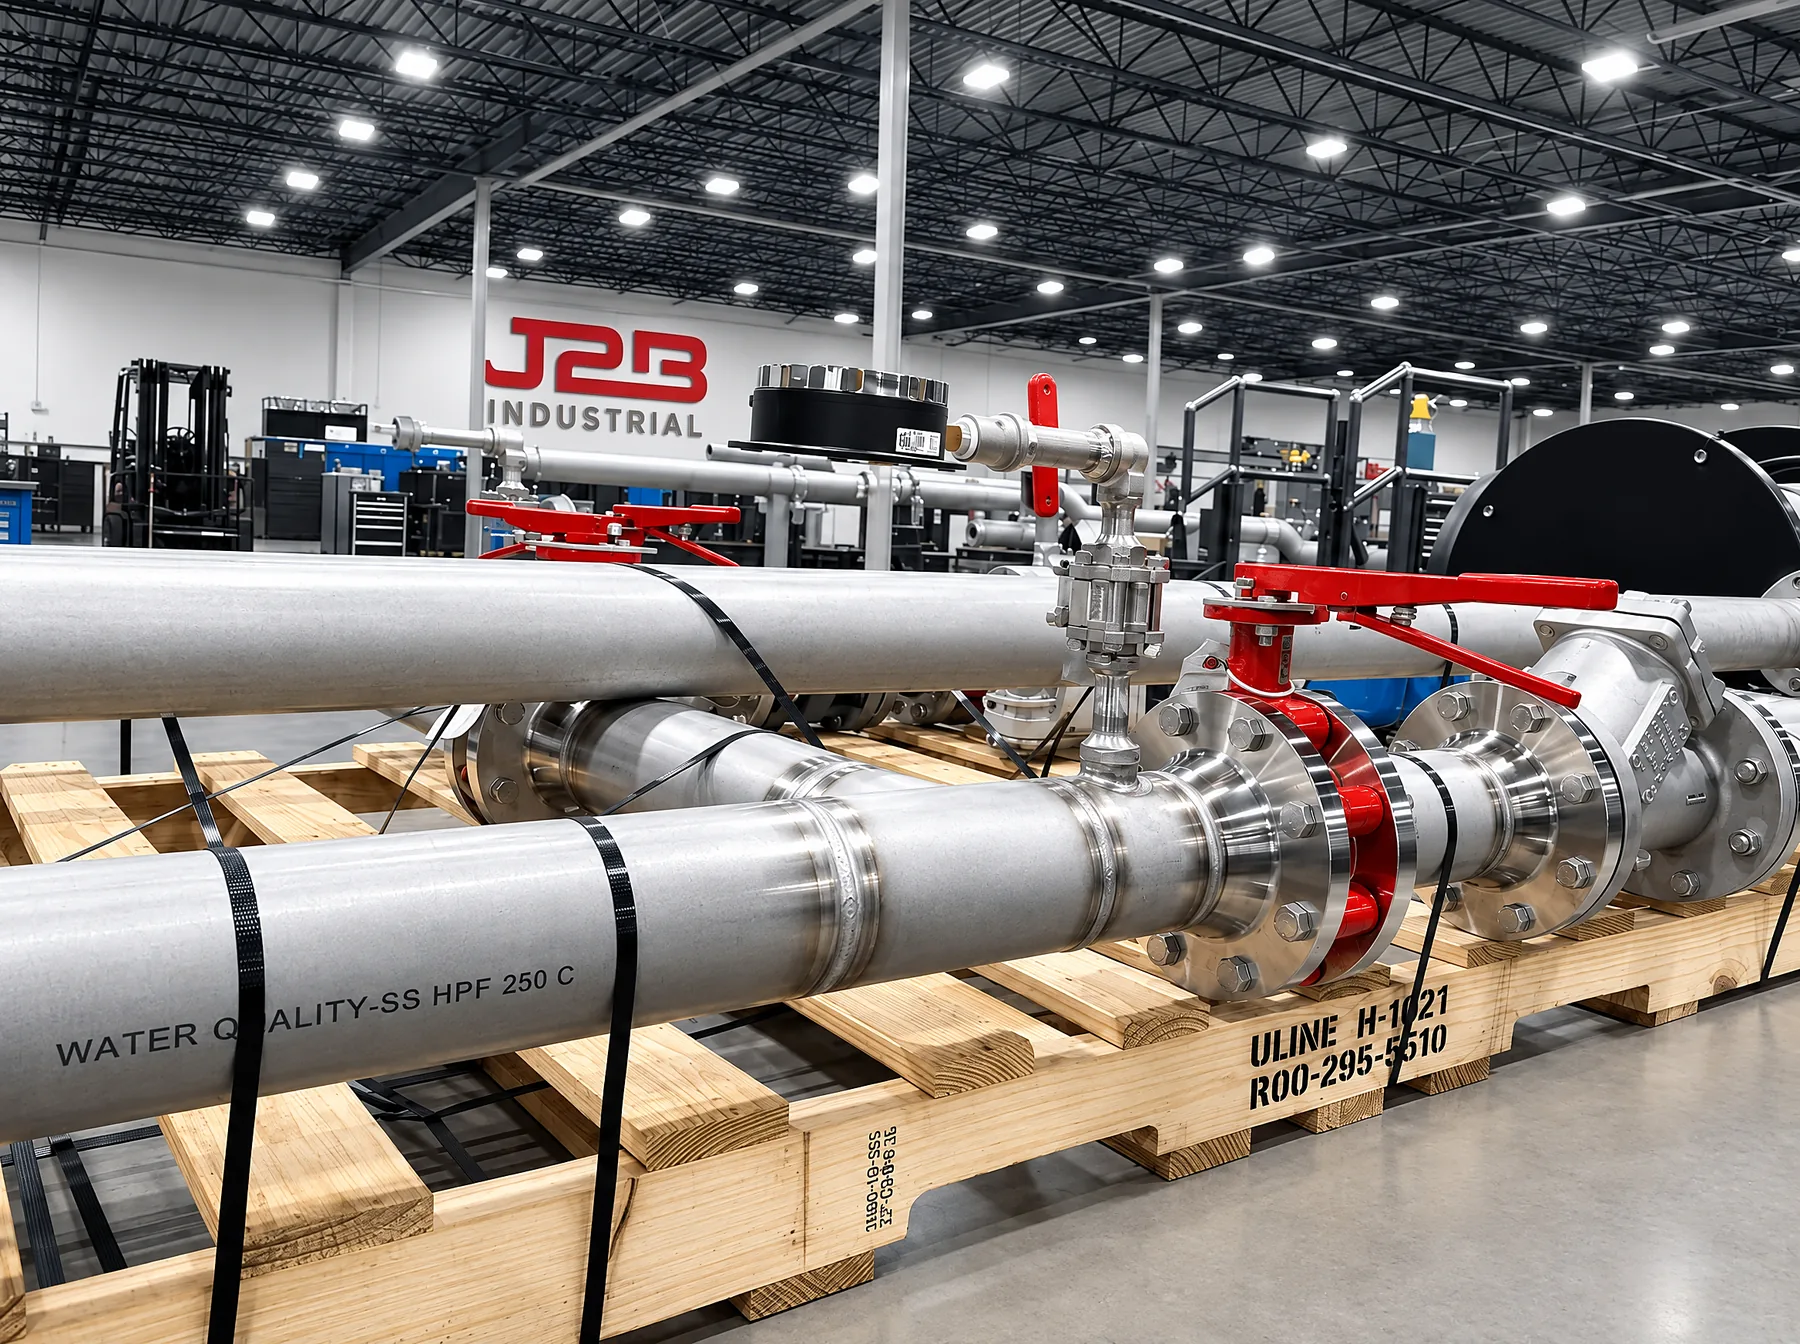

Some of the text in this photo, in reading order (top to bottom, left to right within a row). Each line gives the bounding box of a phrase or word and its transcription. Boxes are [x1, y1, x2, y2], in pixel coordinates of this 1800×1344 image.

[485, 317, 708, 403] J2B
[488, 399, 702, 437] INDUSTRIAL
[55, 965, 575, 1066] WATER QALITY-SS HPF 250 C
[1250, 1014, 1339, 1067] ULINE
